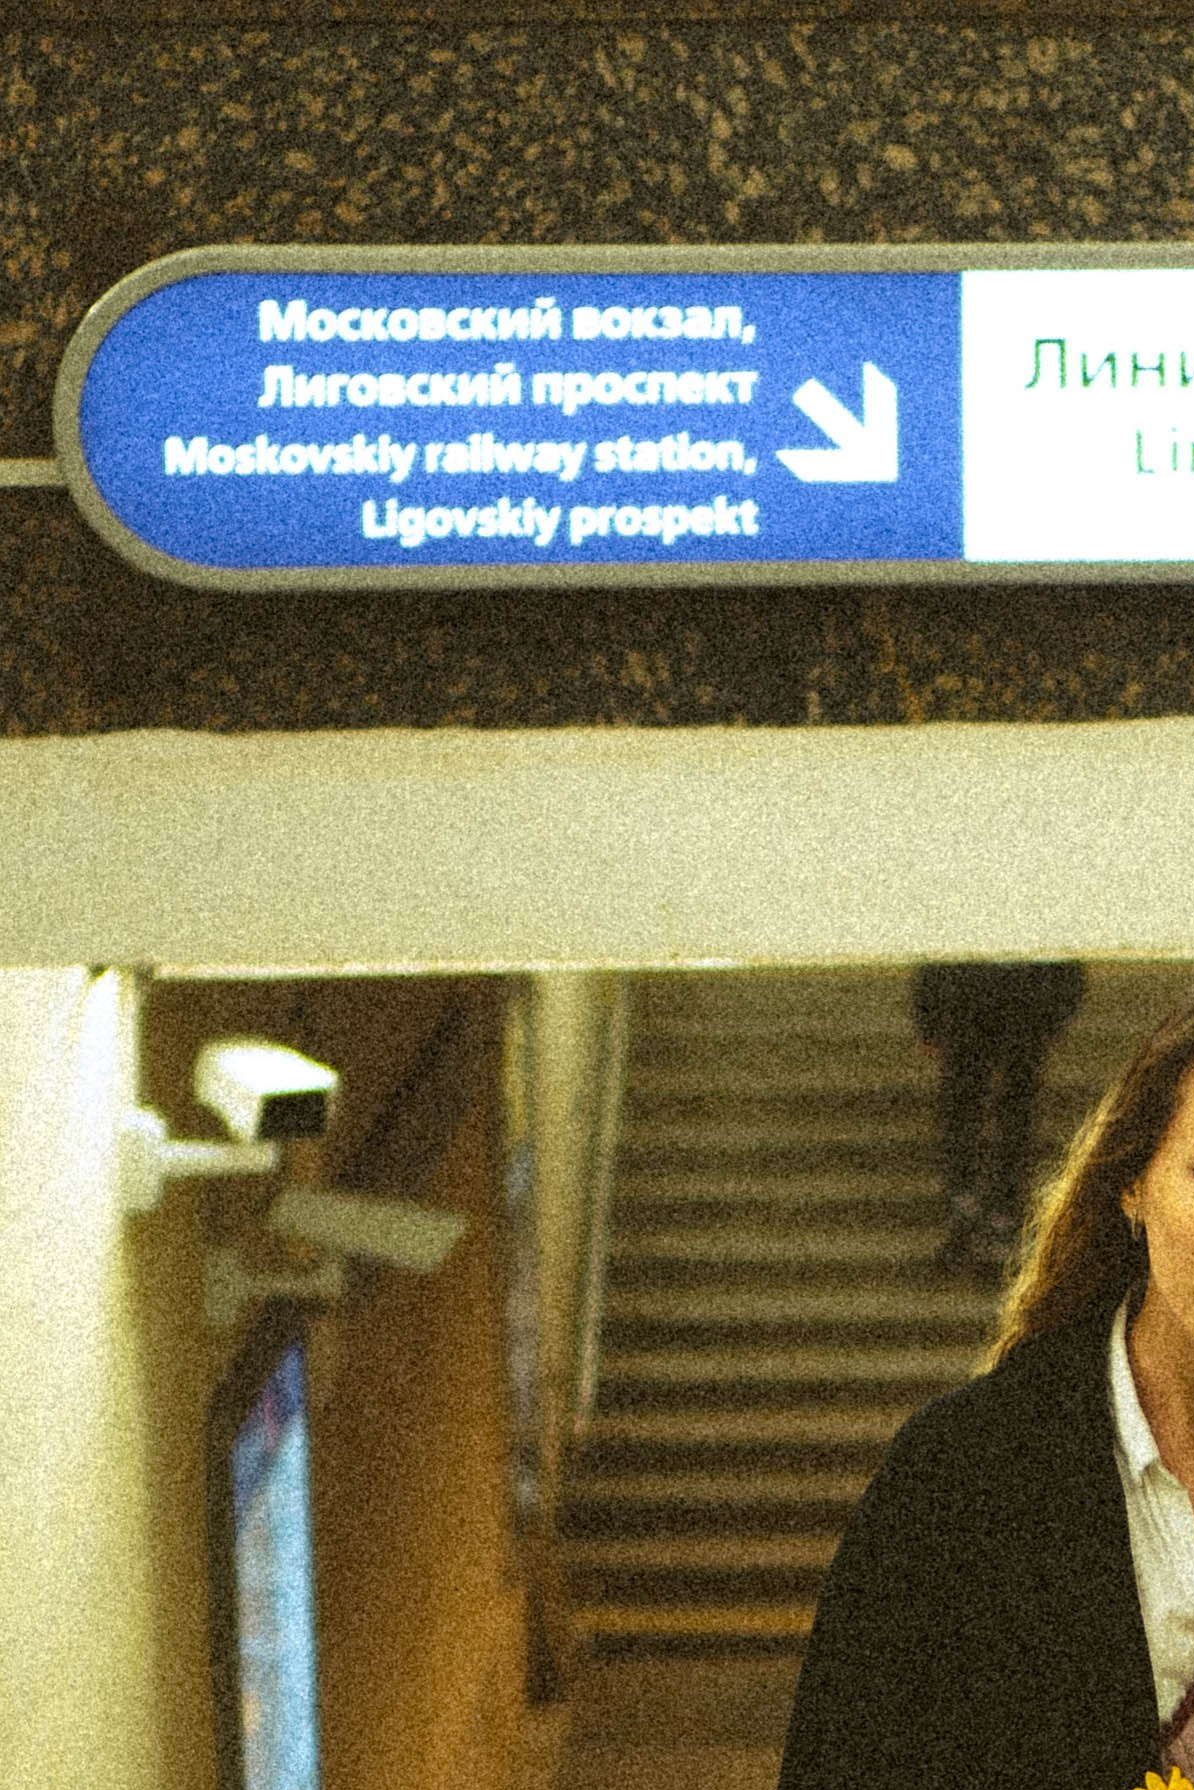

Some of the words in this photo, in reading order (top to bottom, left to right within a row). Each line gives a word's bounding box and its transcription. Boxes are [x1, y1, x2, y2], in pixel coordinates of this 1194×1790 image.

[258, 297, 562, 343] Московский
[572, 305, 757, 344] вокзал,
[258, 362, 522, 409] Лиговский
[532, 369, 760, 416] проспект
[164, 434, 417, 484] Moskovskiy
[424, 433, 589, 482] railway
[595, 432, 758, 476] station,
[362, 497, 562, 547] Ligovskiy
[569, 496, 760, 545] prospekt
